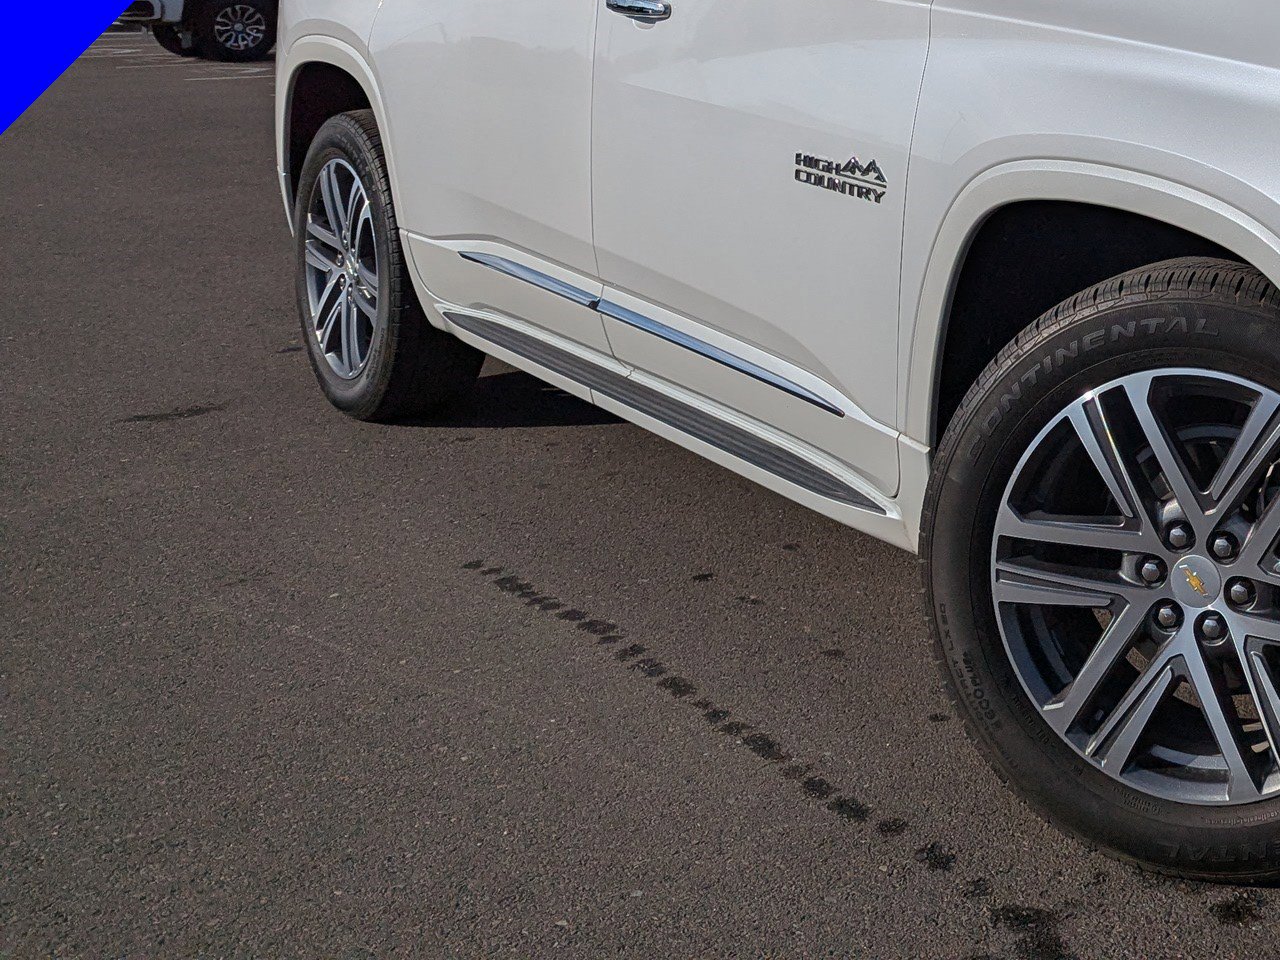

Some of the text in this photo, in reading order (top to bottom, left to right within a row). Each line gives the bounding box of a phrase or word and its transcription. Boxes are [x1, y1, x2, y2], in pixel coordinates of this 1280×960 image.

[795, 153, 842, 175] HIGH
[795, 169, 887, 204] COUNTRY
[967, 316, 1220, 467] CONTINENTAL
